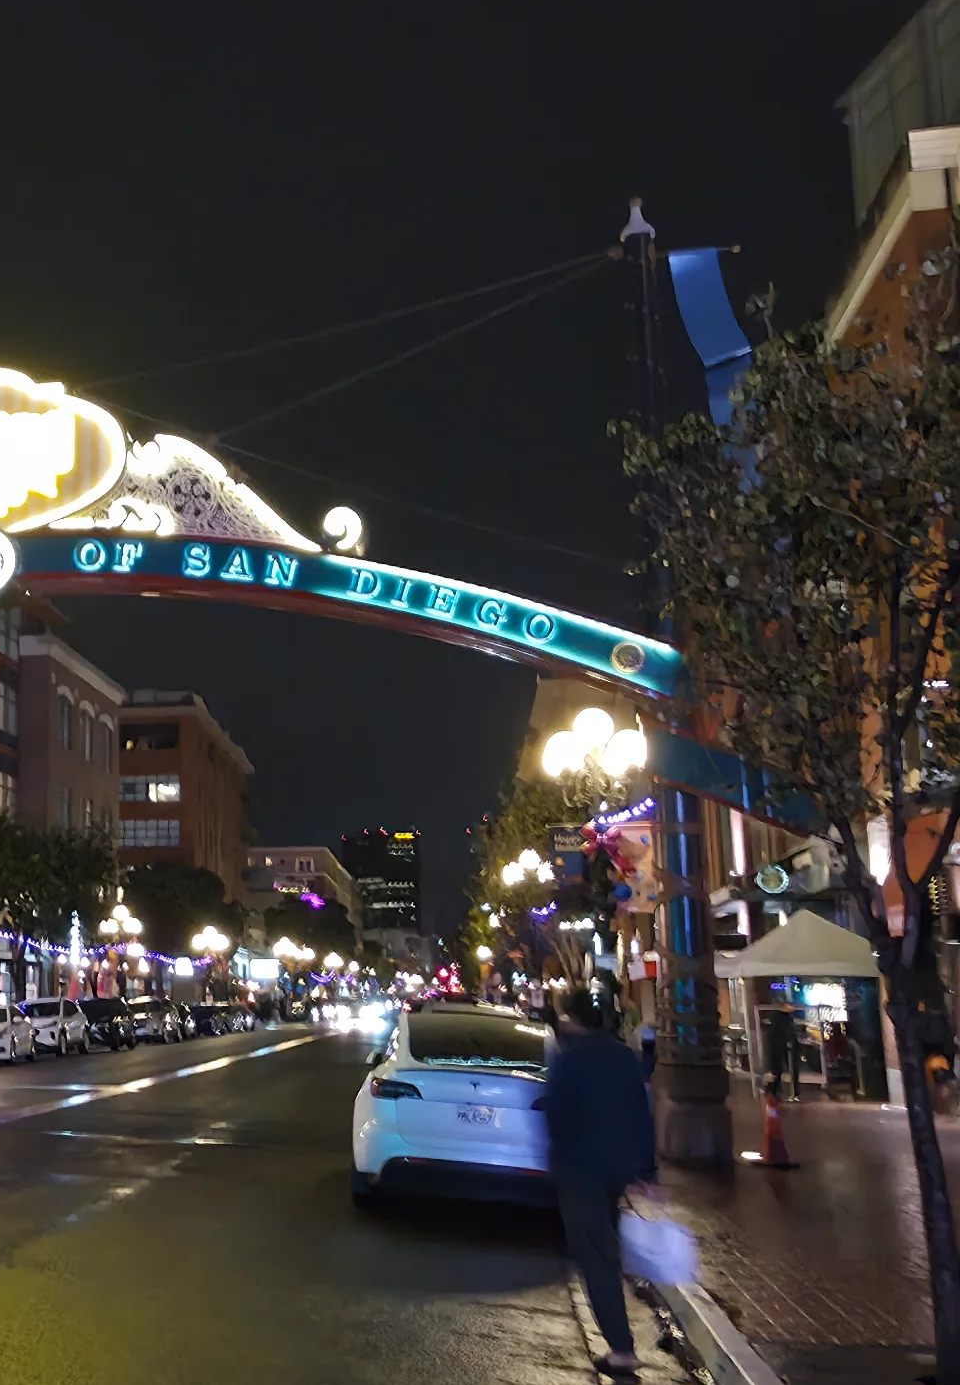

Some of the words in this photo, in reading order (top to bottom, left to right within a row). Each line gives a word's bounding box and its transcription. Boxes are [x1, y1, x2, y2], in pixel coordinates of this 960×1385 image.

[73, 538, 144, 573] OF
[182, 542, 299, 588] SAN
[346, 567, 556, 645] DIEGO
